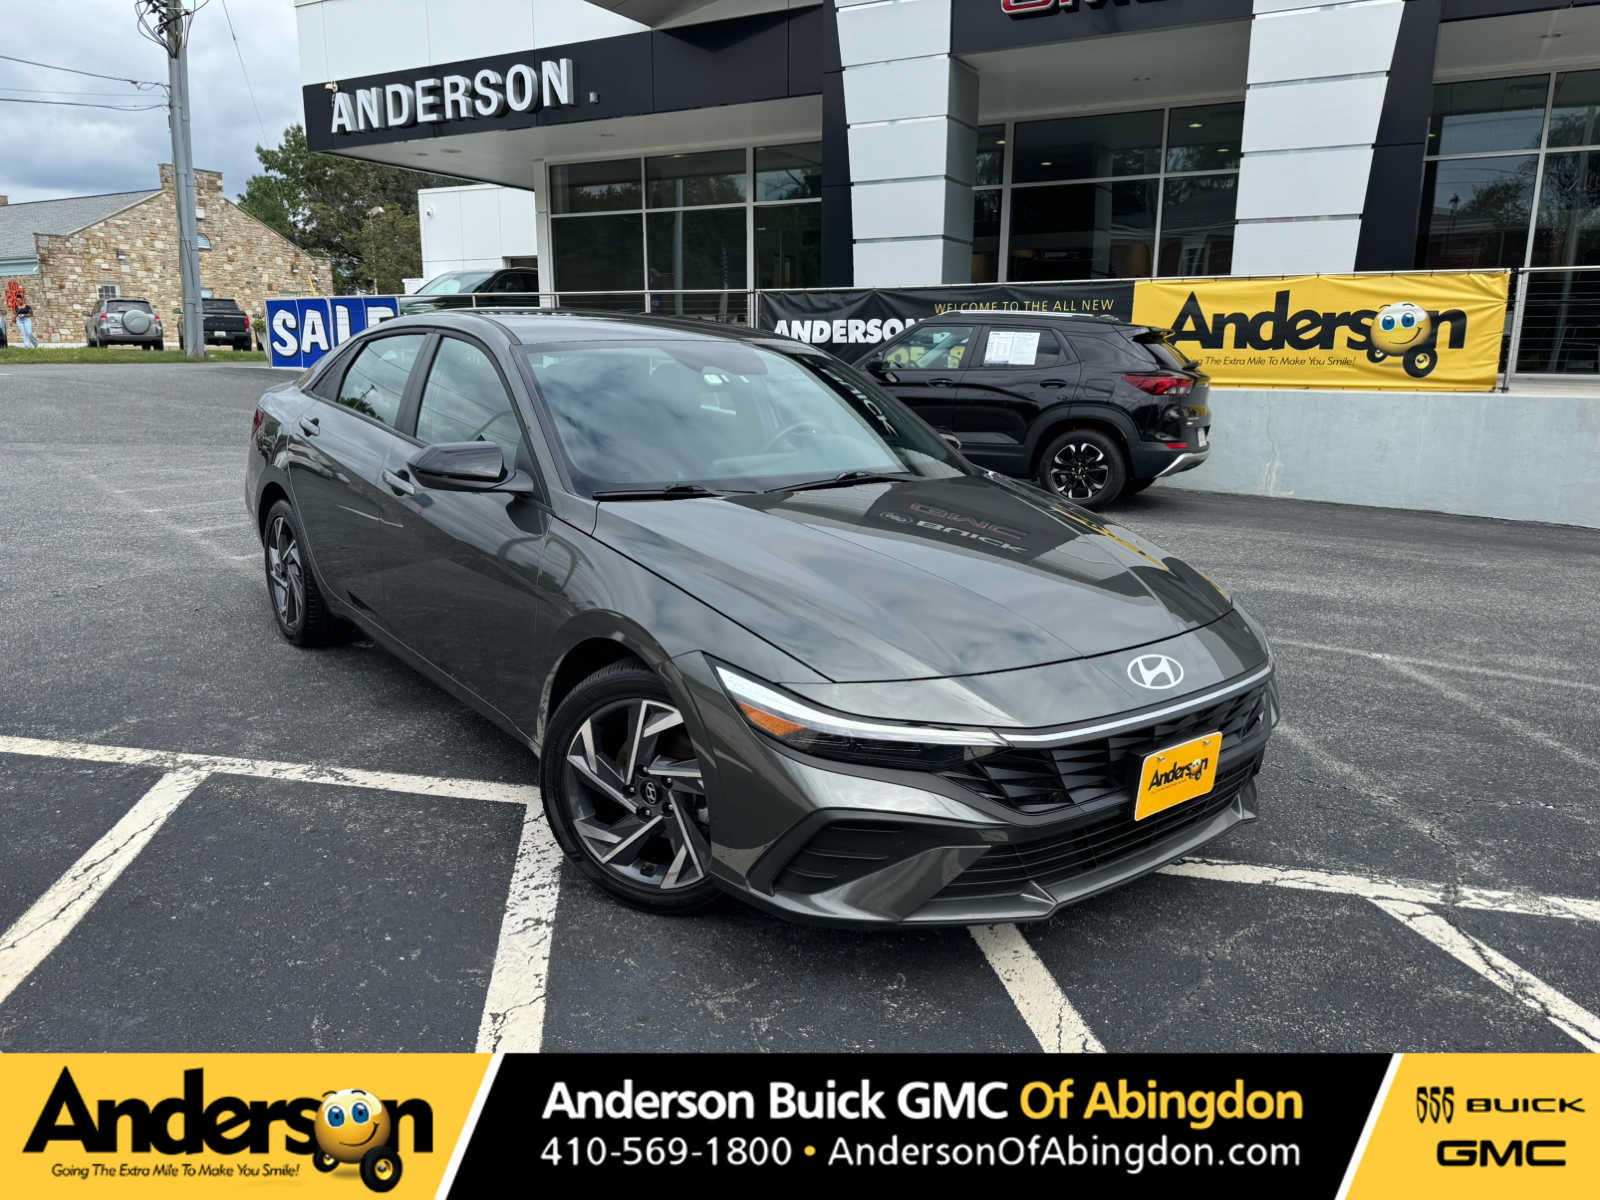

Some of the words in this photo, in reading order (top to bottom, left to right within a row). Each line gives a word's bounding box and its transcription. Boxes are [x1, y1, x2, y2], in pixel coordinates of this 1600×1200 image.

[331, 58, 574, 133] ANDERSON
[1002, 301, 1019, 311] TO
[1024, 301, 1048, 312] THE
[1053, 300, 1077, 311] ALL
[1082, 299, 1115, 311] NEW
[1205, 356, 1221, 366] The
[1223, 356, 1245, 366] Extra
[1247, 356, 1265, 366] Mile
[1268, 356, 1279, 366] To
[1280, 356, 1306, 366] Make
[1309, 356, 1325, 366] You
